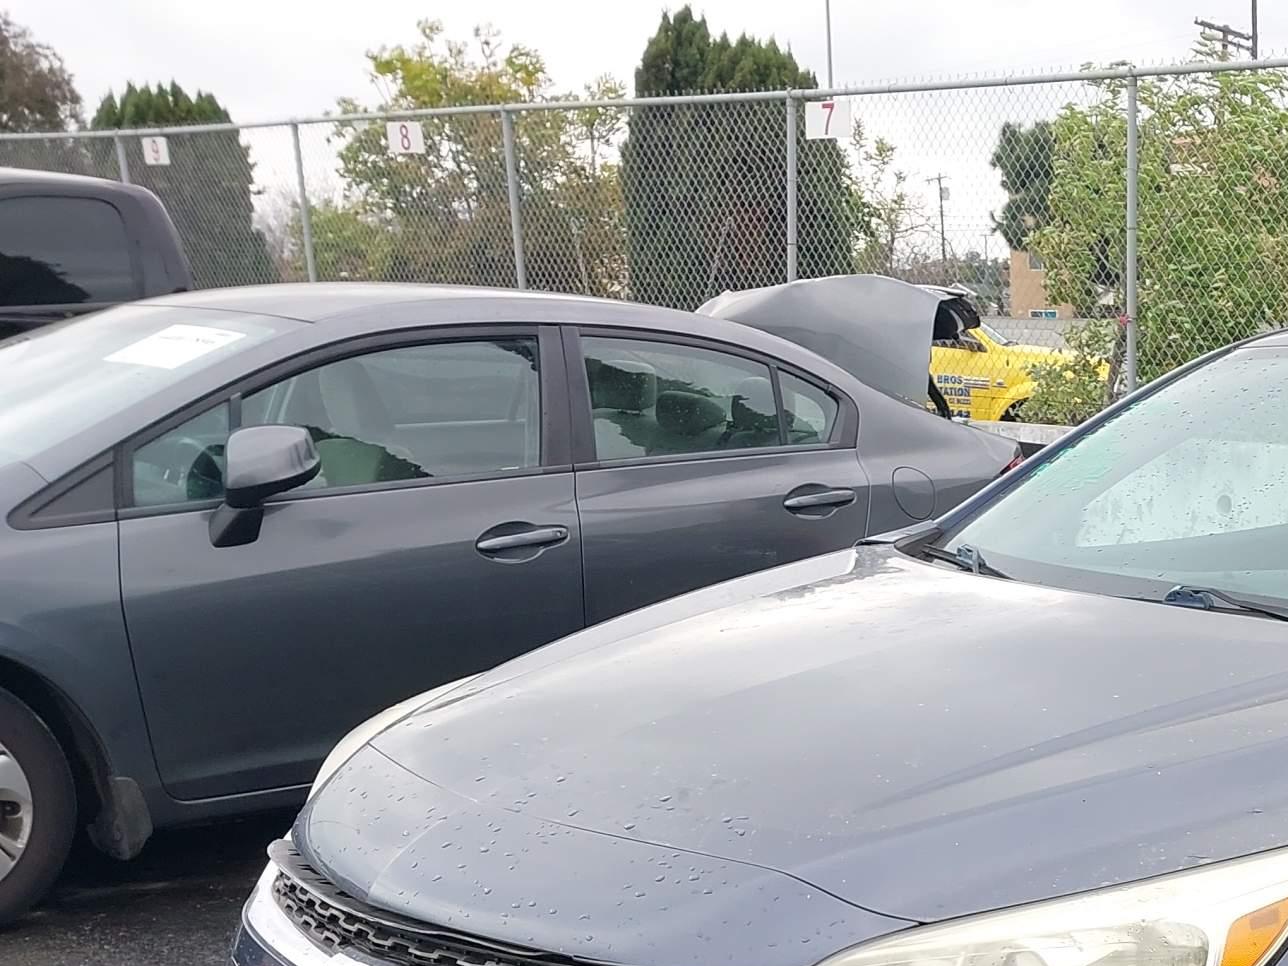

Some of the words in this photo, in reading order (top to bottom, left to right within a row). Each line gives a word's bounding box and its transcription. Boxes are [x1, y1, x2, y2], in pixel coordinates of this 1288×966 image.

[821, 102, 835, 136] 7
[399, 124, 411, 151] 8
[937, 375, 963, 384] BROS
